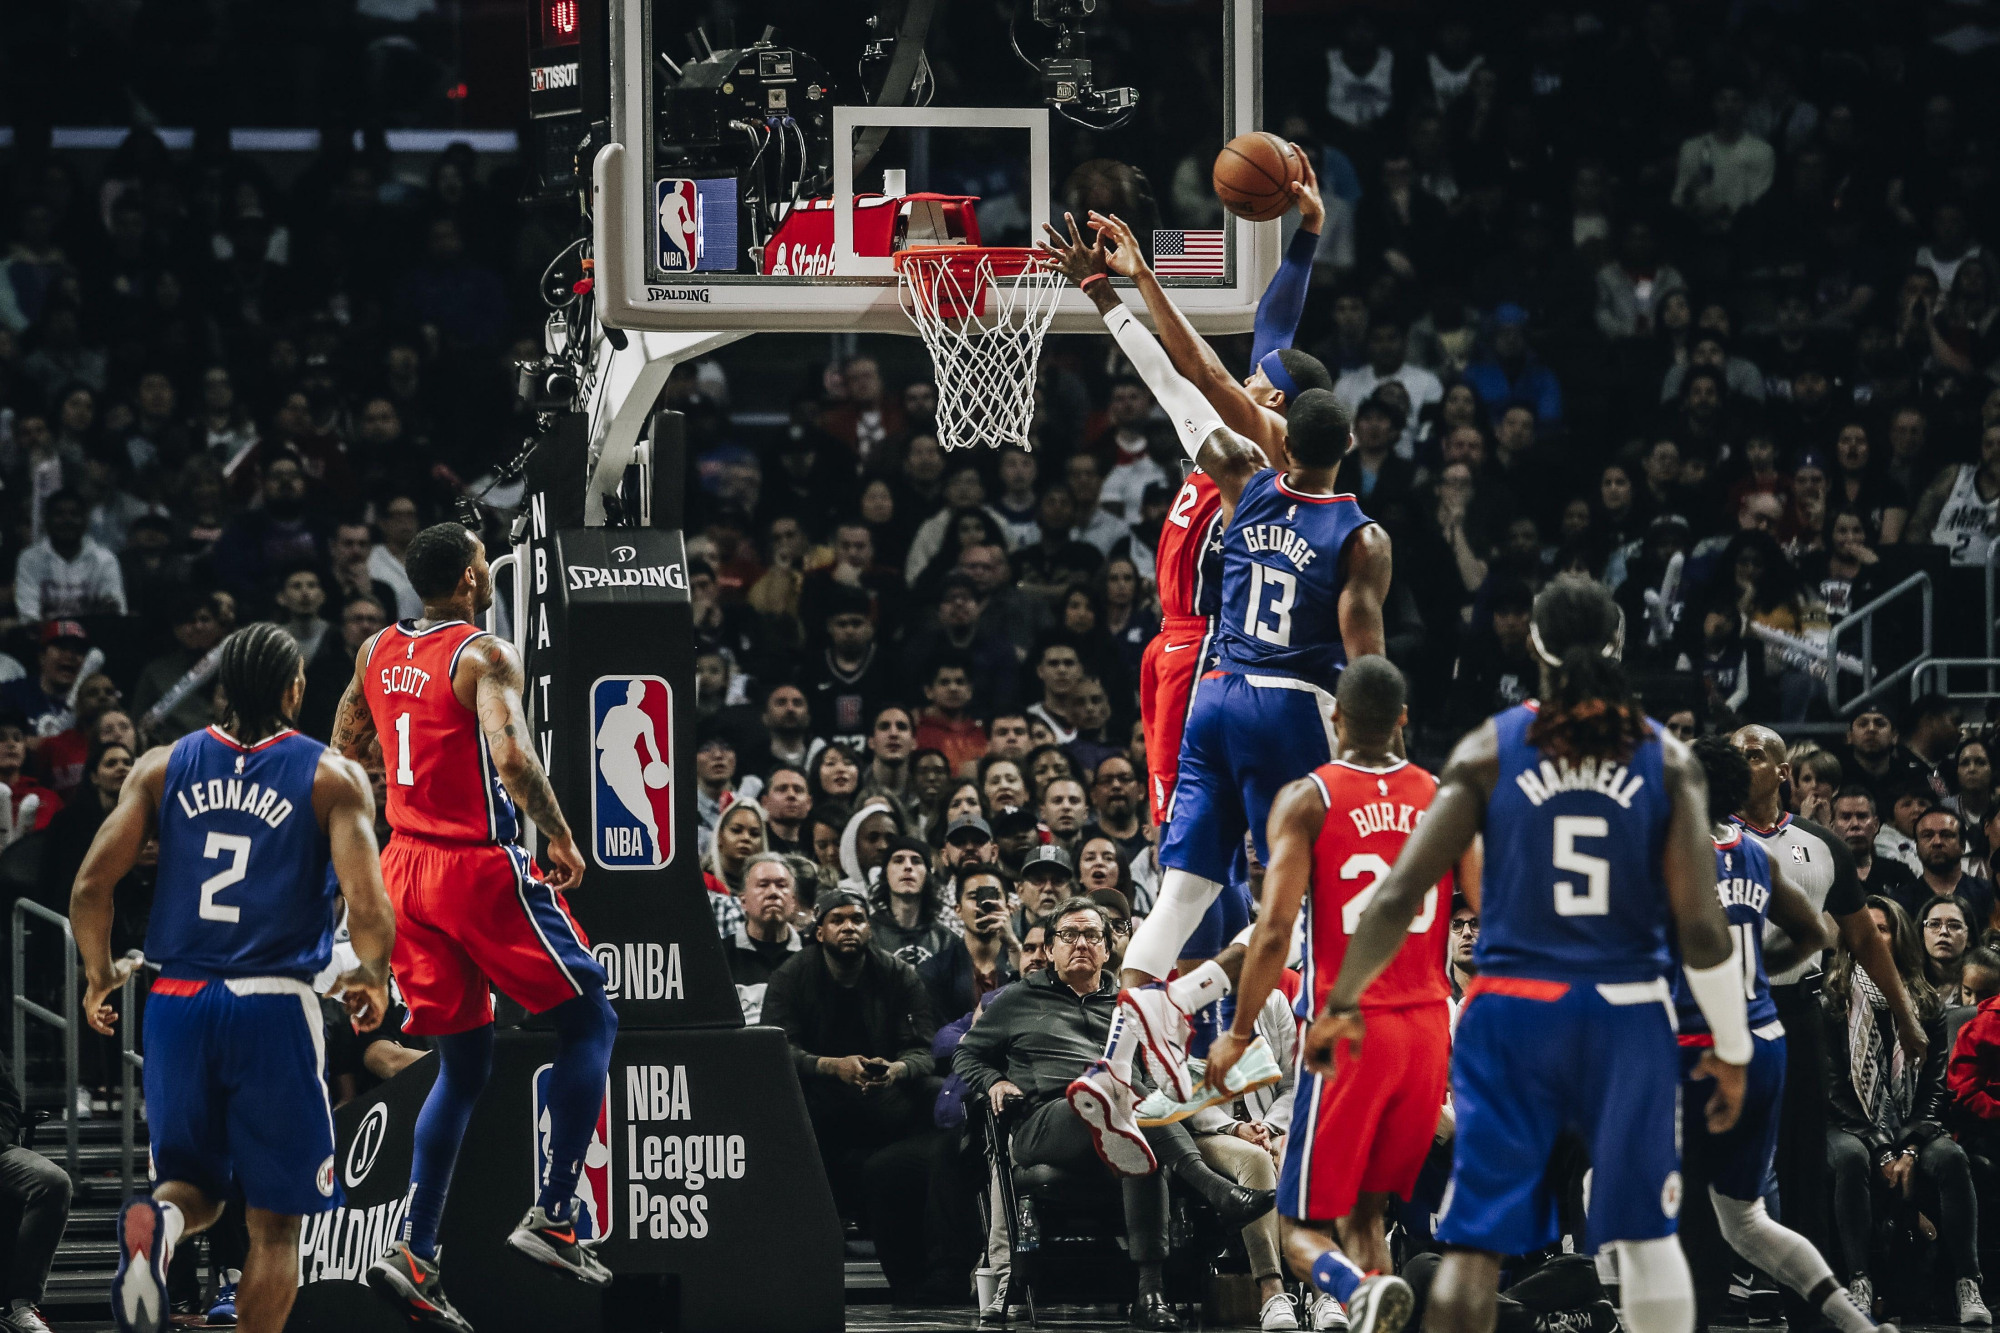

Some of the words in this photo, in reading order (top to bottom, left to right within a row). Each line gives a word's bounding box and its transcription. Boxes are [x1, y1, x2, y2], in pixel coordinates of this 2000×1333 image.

[663, 251, 683, 267] NBA
[647, 287, 709, 303] SPALDING
[531, 491, 551, 650] NBA
[567, 563, 688, 591] SPALDING
[1242, 524, 1318, 573] GEORGE
[1243, 561, 1297, 648] 13
[381, 665, 431, 698] SCOTT
[395, 712, 414, 787] 1
[539, 674, 553, 777] TV
[176, 777, 294, 829] LEONARD
[604, 826, 644, 857] NBA
[1552, 815, 1611, 917] 5
[199, 830, 252, 923] 2
[591, 942, 685, 1001] @NBA
[626, 1065, 692, 1121] NBA
[627, 1124, 747, 1191] League
[629, 1183, 709, 1240] Pass
[297, 1195, 408, 1288] PALDIN
